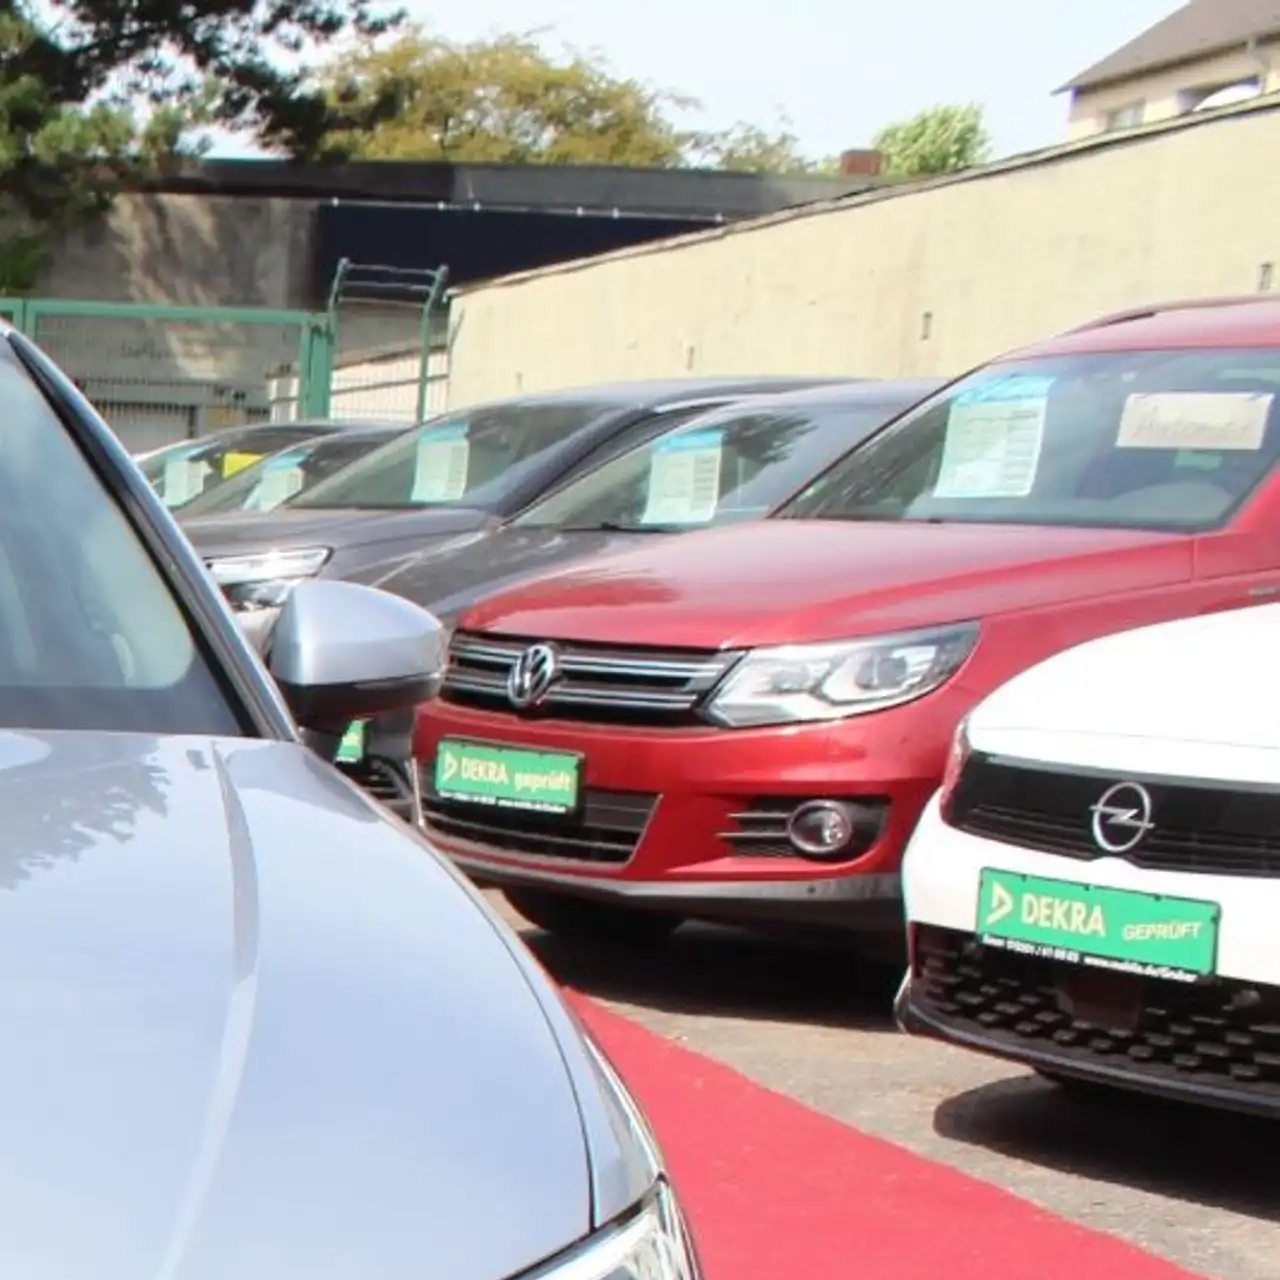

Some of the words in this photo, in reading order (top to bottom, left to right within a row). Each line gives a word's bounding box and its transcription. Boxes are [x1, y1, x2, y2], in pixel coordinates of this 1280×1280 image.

[461, 757, 509, 784] DEKRA
[1020, 893, 1106, 936] DEKRA
[1122, 919, 1203, 941] GEPRÜFT
